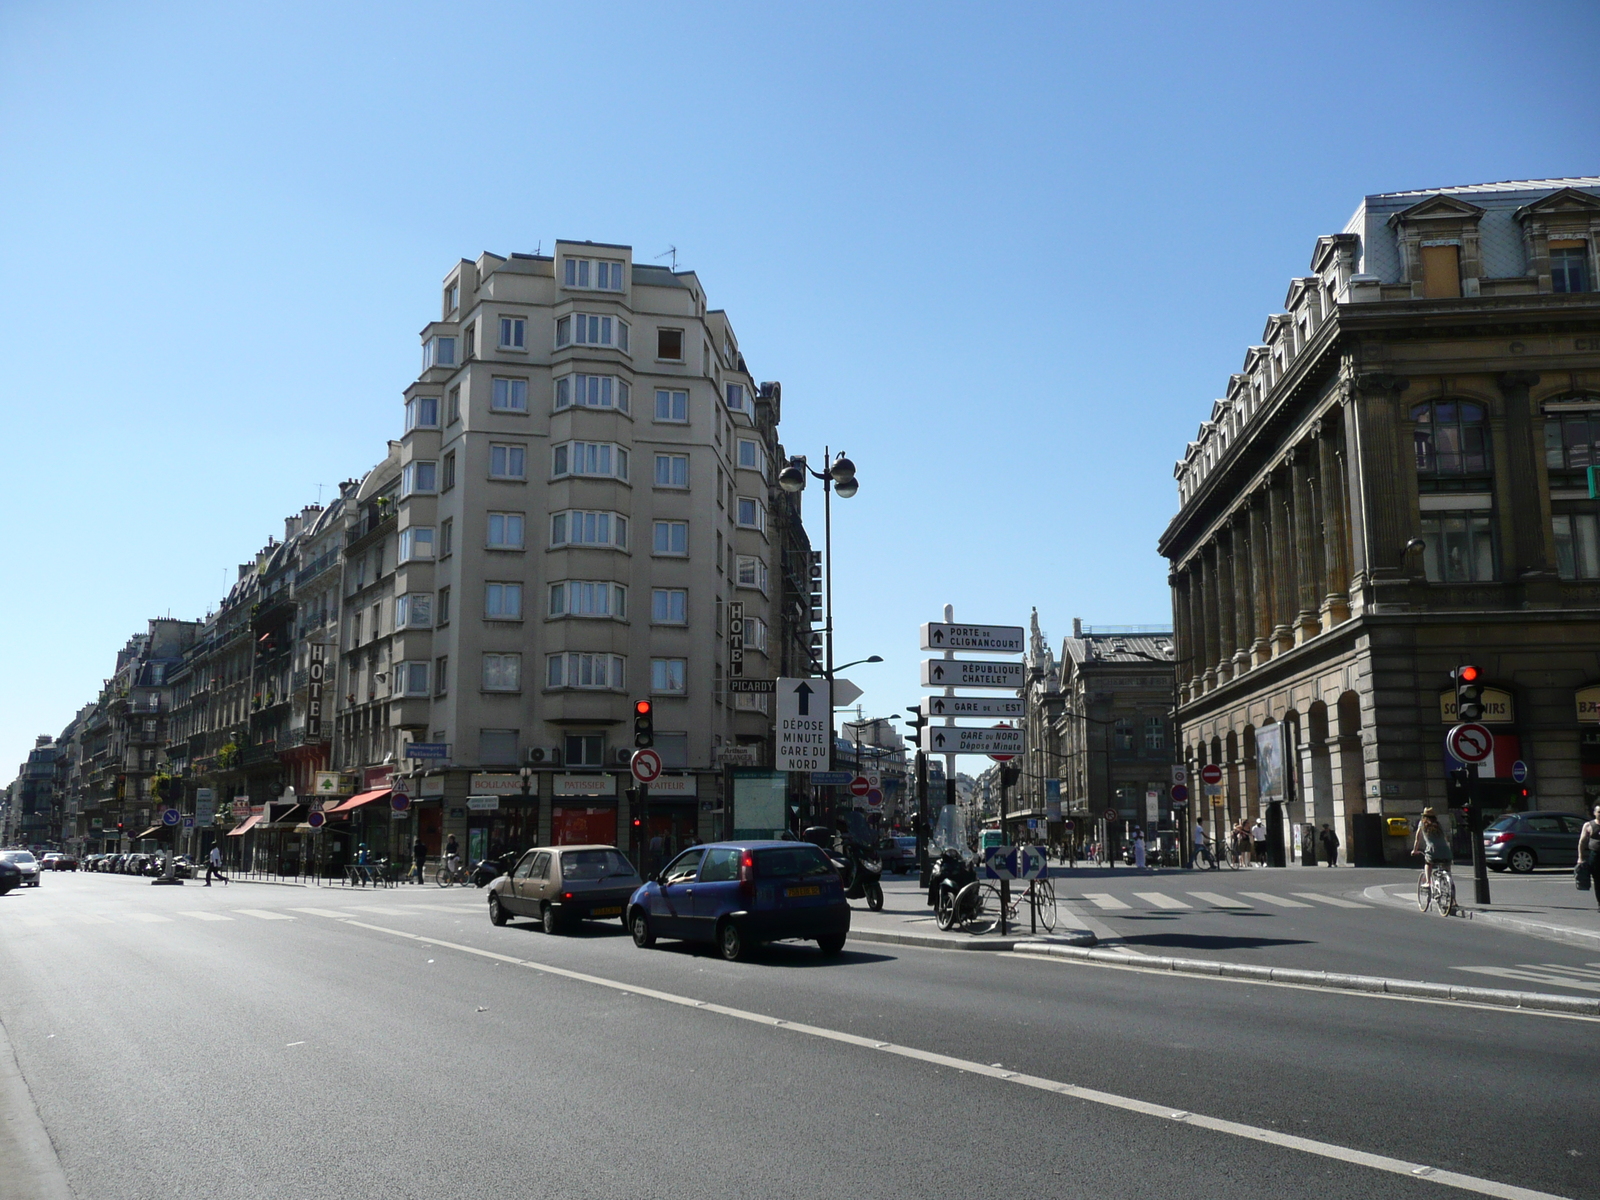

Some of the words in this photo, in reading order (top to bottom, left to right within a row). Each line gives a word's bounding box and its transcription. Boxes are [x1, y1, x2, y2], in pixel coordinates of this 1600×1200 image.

[809, 552, 822, 622] HOTEL
[950, 627, 979, 637] PORTE
[731, 605, 743, 678] HOTEL
[950, 638, 1019, 648] CLIGNANCOURT
[962, 663, 1020, 675] RÉPUBLIQUE
[962, 674, 1007, 684] CHATELET
[309, 645, 323, 736] HOTEL
[732, 681, 774, 692] PICARDY
[954, 702, 978, 711] GARE
[1444, 703, 1505, 714] SONIRS
[783, 718, 824, 731] DÉPOSE
[783, 732, 823, 744] MINUTE
[960, 731, 983, 740] GARE
[995, 732, 1019, 741] NORD
[781, 745, 808, 756] GARE
[812, 746, 826, 757] DU
[960, 740, 990, 750] Dépose
[992, 741, 1022, 751] Minute
[788, 759, 818, 770] NORD
[564, 781, 606, 790] PATISSIER
[647, 781, 685, 790] RAITEUR
